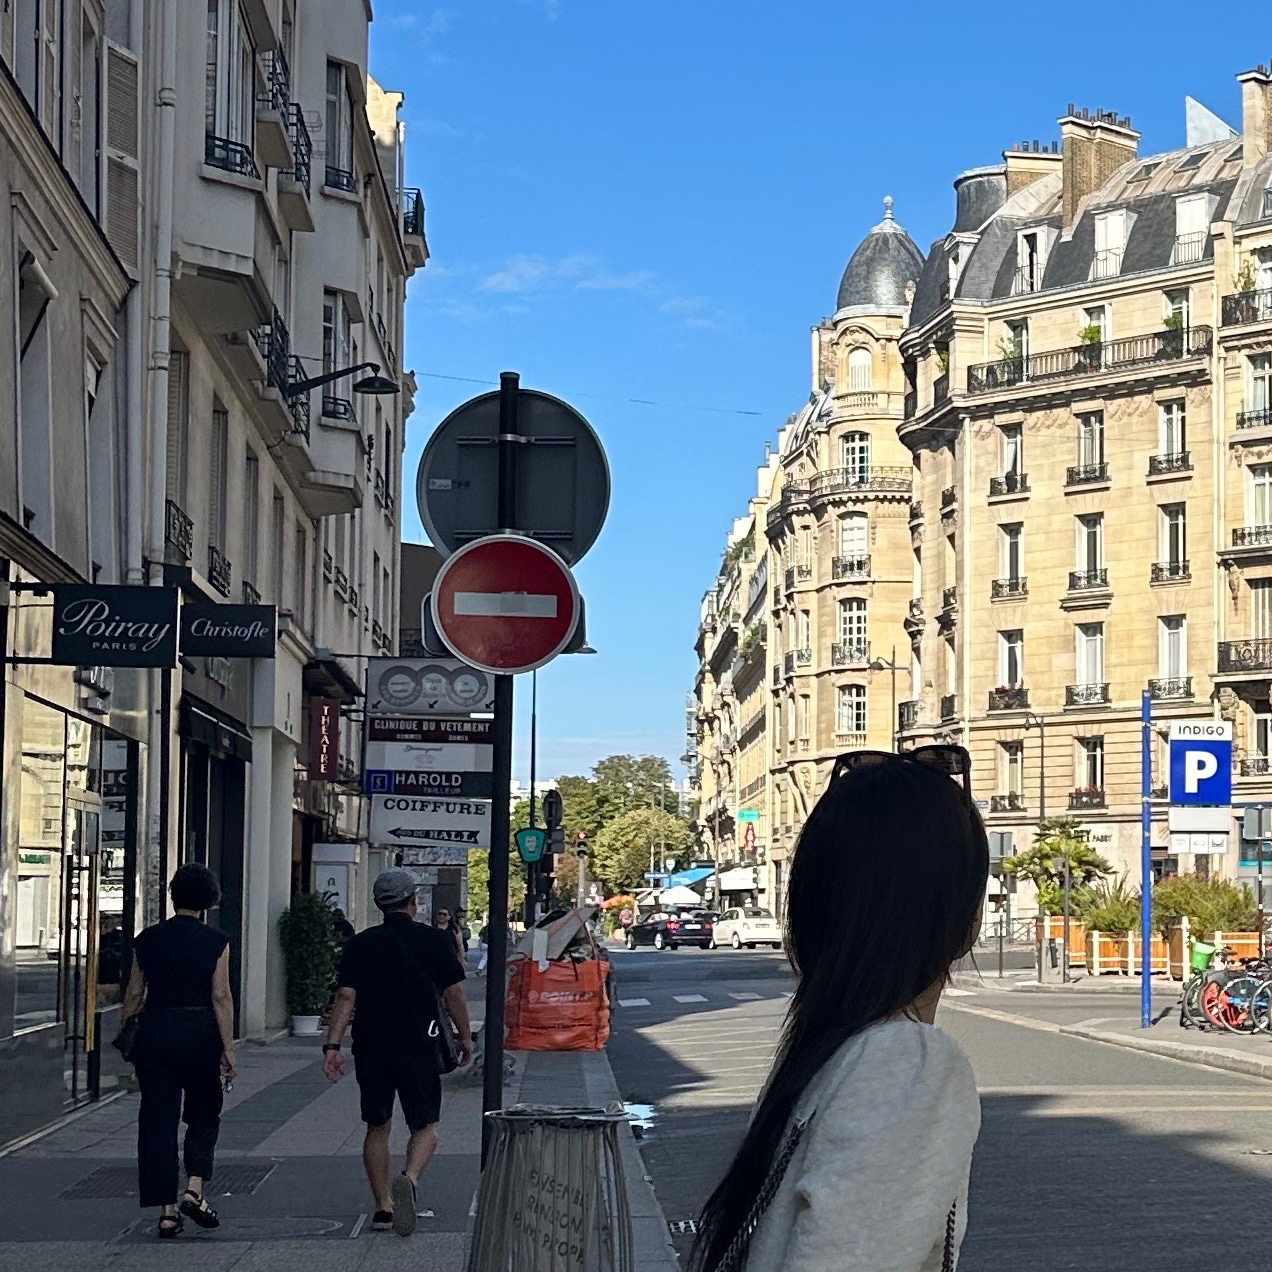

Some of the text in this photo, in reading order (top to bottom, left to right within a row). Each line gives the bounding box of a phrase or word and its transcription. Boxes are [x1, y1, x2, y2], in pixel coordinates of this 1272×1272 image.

[59, 598, 171, 652] Poiray
[190, 617, 270, 641] Christofle
[92, 641, 137, 651] PARIS
[374, 719, 419, 731] CLINIQUE
[422, 720, 436, 731] DU
[1178, 725, 1225, 737] INDIGO
[395, 772, 462, 786] HAROLD
[1184, 750, 1218, 794] P
[383, 797, 487, 816] COIFFURE
[429, 830, 476, 842] HALL
